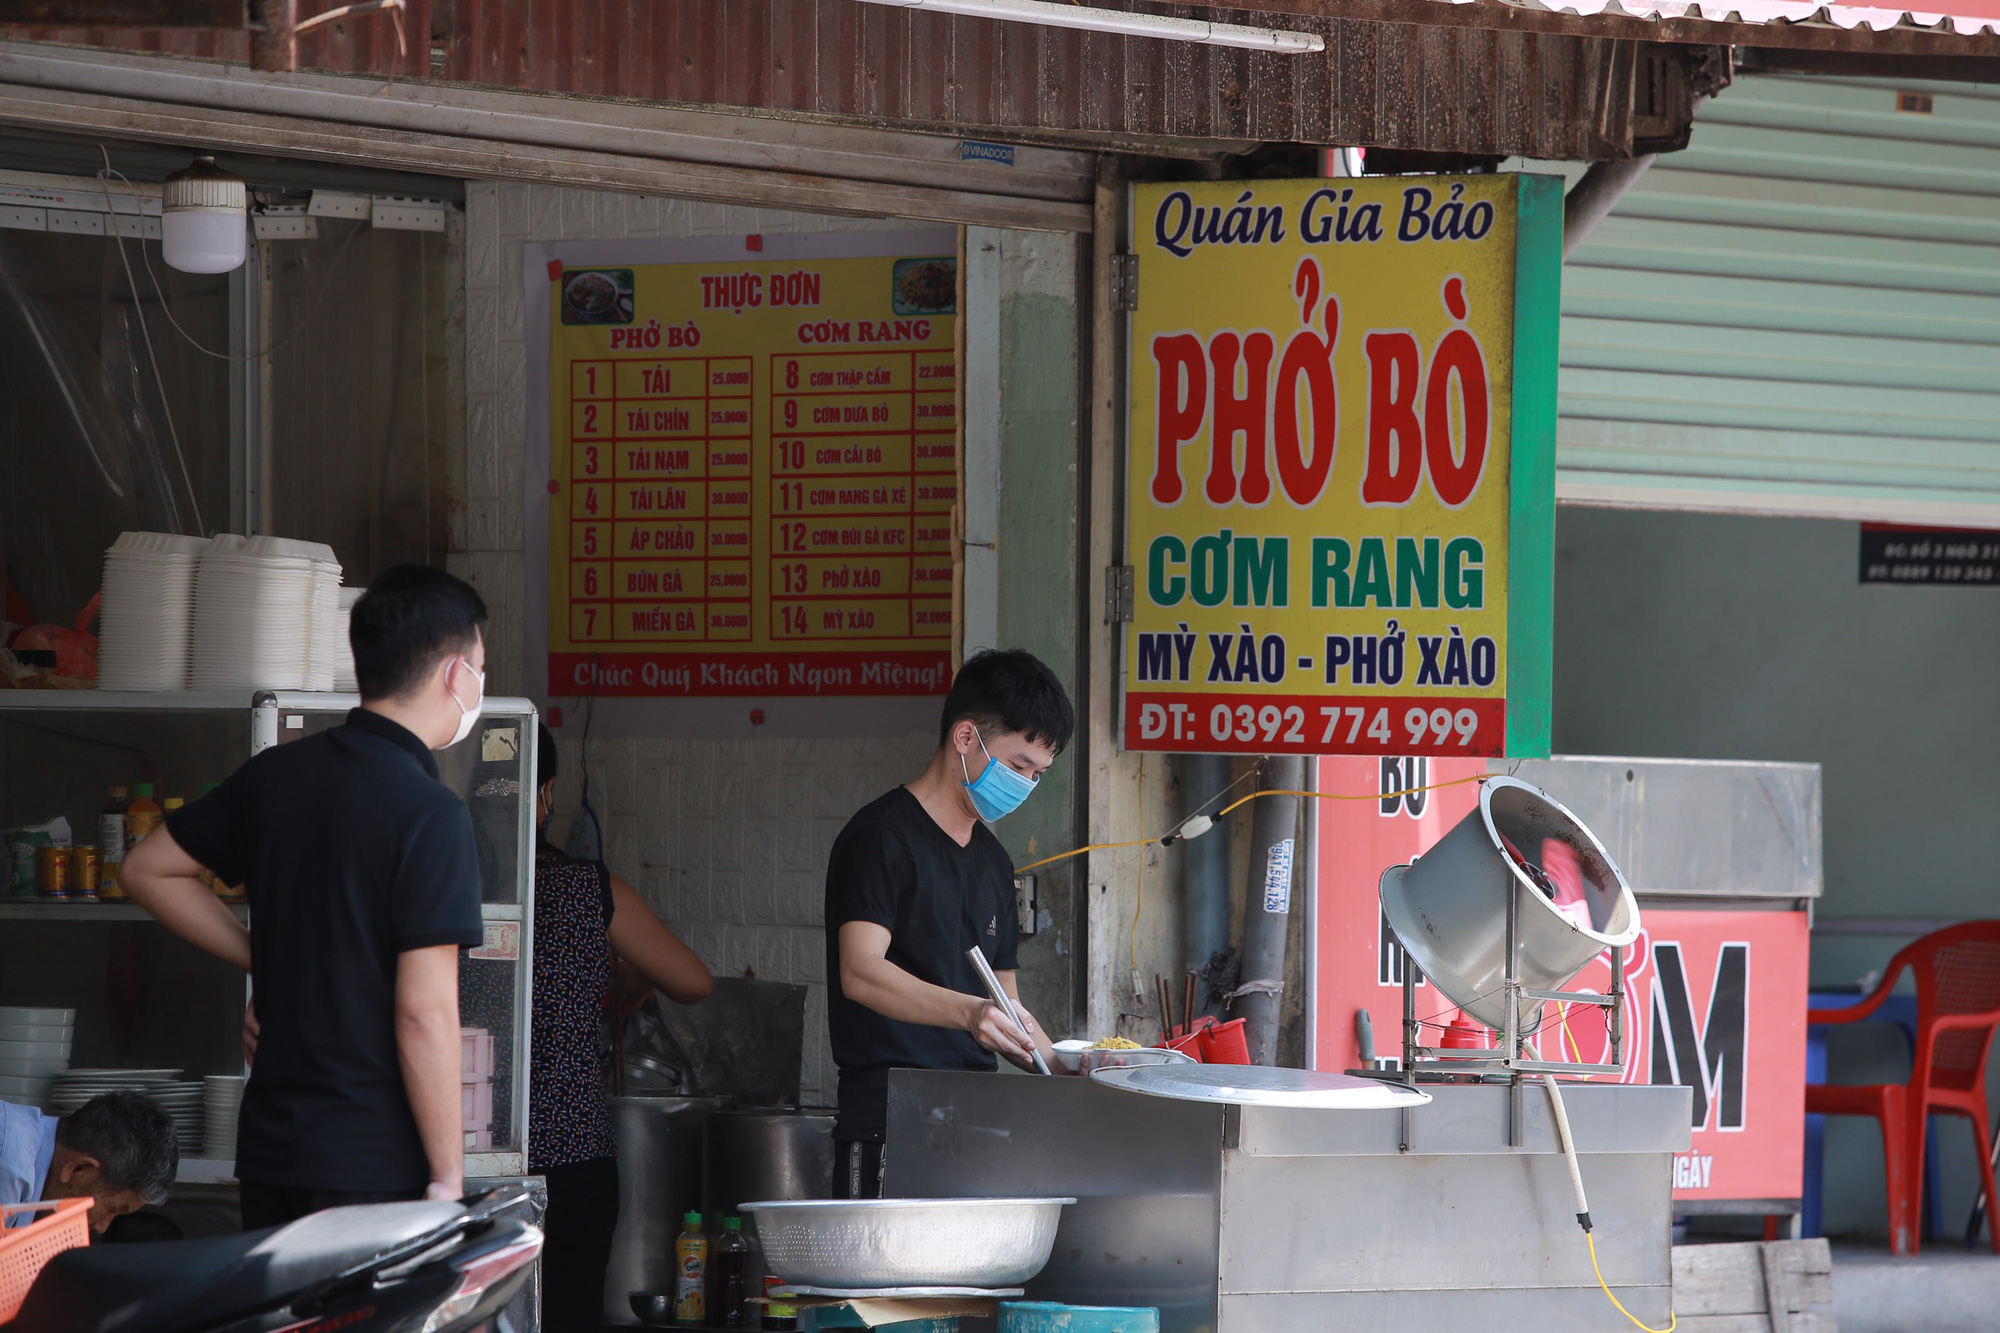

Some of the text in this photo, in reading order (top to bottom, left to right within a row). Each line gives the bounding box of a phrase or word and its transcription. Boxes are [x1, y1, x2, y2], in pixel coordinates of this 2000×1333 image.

[1155, 190, 1286, 258] Quán
[1397, 183, 1494, 241] Bảo
[699, 270, 821, 315] THỰC ĐƠN
[610, 319, 701, 349] PHỞ BÒ
[797, 318, 932, 344] CƠM RANG
[585, 366, 597, 395] 1
[641, 364, 671, 394] TÁI
[786, 360, 799, 389] 8
[809, 371, 834, 387] CƠM
[836, 369, 864, 389] THẬP
[1151, 257, 1489, 506] PHỞ BÒ
[583, 404, 597, 433] 2
[627, 407, 650, 431] TÁI
[654, 407, 690, 431] CHÍN
[784, 399, 798, 429] 9
[813, 406, 841, 424] CƠM
[872, 402, 889, 422] BÒ
[585, 446, 598, 475] 3
[627, 448, 650, 471] TÁI
[655, 450, 689, 475] NẠM
[779, 440, 805, 470] 10
[816, 449, 841, 465] CƠM
[866, 445, 882, 464] BÒ
[584, 486, 598, 515] 4
[630, 486, 653, 511] TÁI
[657, 486, 686, 510] LĂN
[780, 482, 803, 511] 11
[810, 489, 836, 506] CƠM
[838, 490, 870, 505] RANG
[872, 487, 888, 504] GÀ
[584, 526, 597, 555] 5
[630, 526, 650, 550] ÁP
[654, 524, 695, 550] CHẢO
[780, 522, 807, 551] 12
[812, 529, 838, 546] CƠM
[864, 527, 880, 545] GÀ
[882, 530, 906, 545] KFC
[584, 567, 597, 596] 6
[627, 569, 658, 593] BÚN
[662, 569, 683, 593] GÀ
[781, 564, 808, 593] 13
[851, 566, 881, 588] XÀO
[1148, 529, 1485, 610] CƠM RANG
[583, 608, 597, 637] 7
[632, 606, 671, 632] MIẾN
[675, 608, 697, 632] GÀ
[781, 605, 808, 635] 14
[823, 608, 844, 631] MỲ
[847, 608, 875, 630] XÀO
[1137, 622, 1197, 682] MỲ
[1207, 623, 1286, 684] XÀO
[1325, 618, 1407, 685] PHỞ
[1415, 626, 1498, 687] XÀO
[572, 660, 945, 693] Chúc Quý Khách Ngon Miệng!
[1139, 703, 1479, 747] ĐT: 0392 774 999
